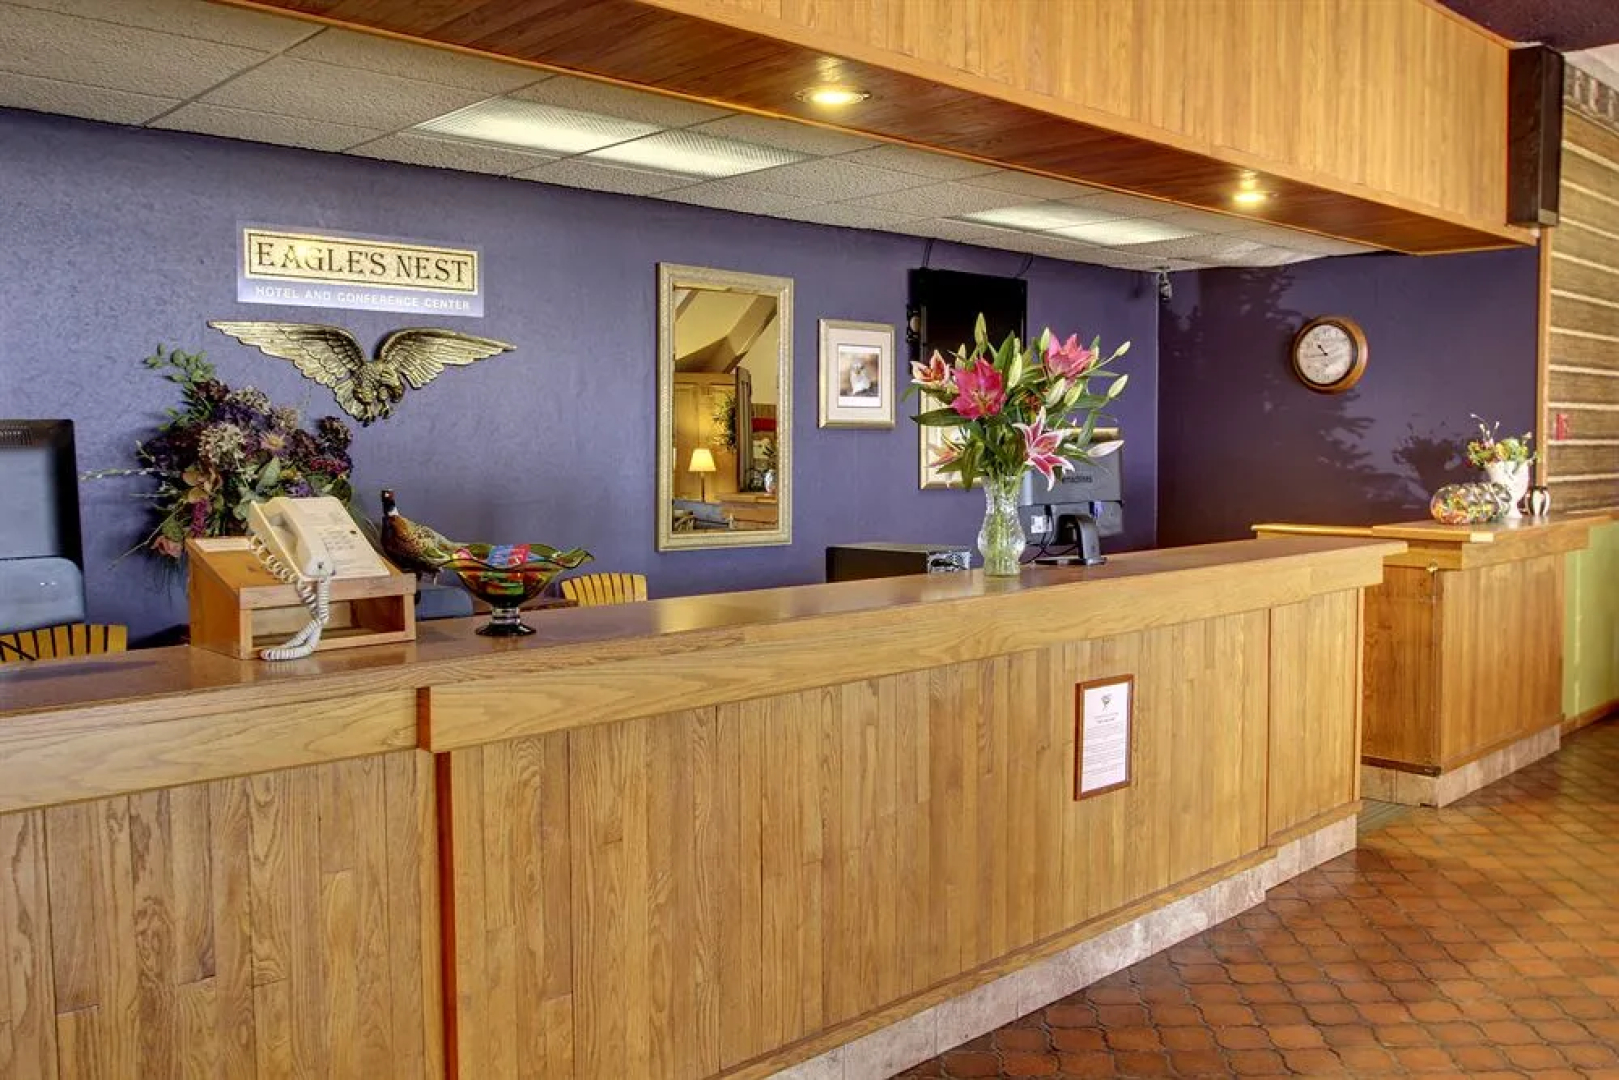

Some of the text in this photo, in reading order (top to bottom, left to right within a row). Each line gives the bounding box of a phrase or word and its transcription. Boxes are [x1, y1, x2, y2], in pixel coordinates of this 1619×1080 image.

[256, 242, 468, 282] EAGLE'S NEST
[256, 286, 469, 310] HOTEL AND CONFERENCE CENTER
